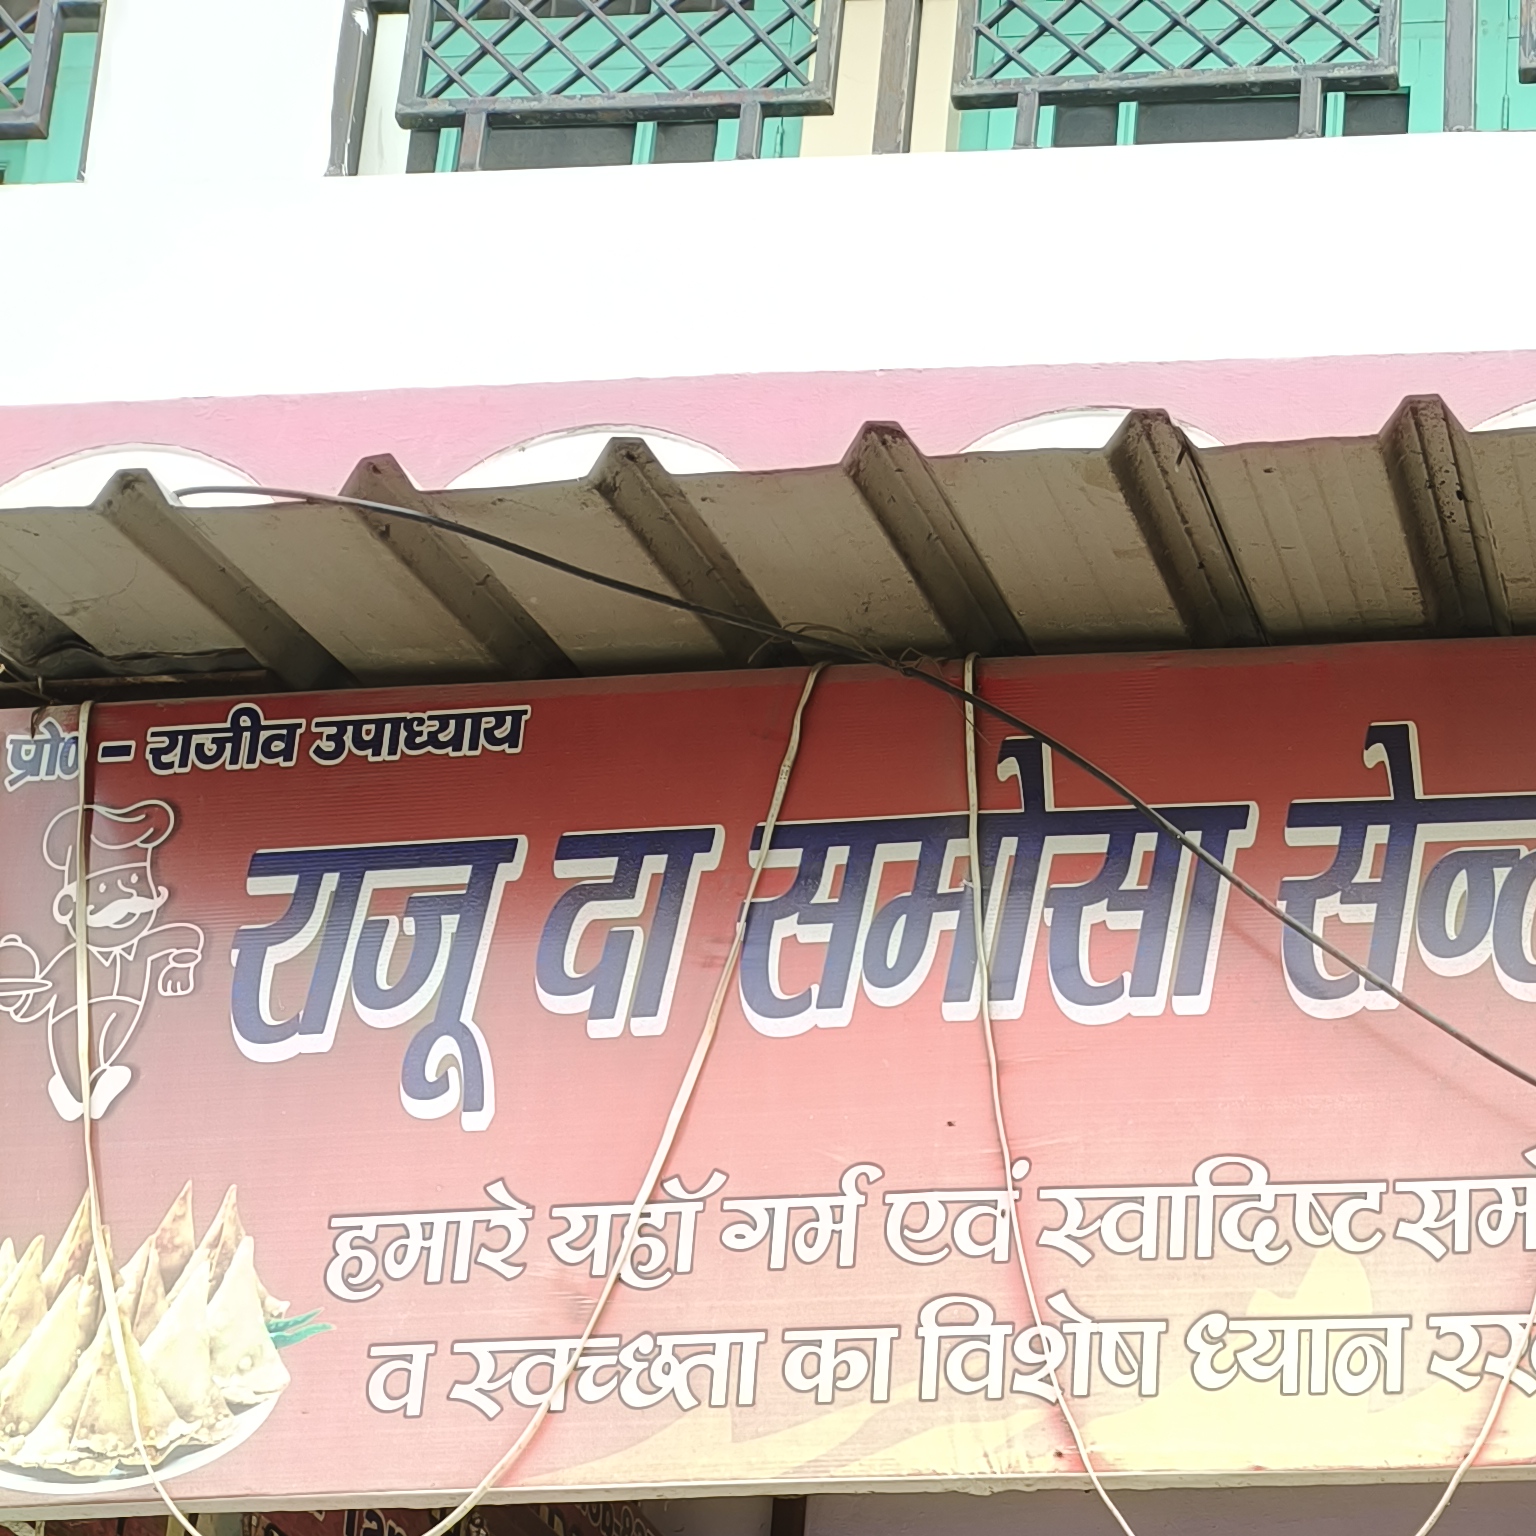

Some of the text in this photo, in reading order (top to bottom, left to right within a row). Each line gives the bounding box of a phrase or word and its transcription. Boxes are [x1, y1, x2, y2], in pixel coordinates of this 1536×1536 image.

[146, 703, 306, 774] राजीव
[310, 704, 532, 764] उपाध्याय
[231, 828, 525, 1130] राजू
[536, 825, 722, 1039] दा
[739, 733, 1259, 1040] समोसा
[325, 1177, 533, 1300] हमारे
[721, 1161, 884, 1271] गर्म
[885, 1157, 1032, 1265] एवं
[1037, 1153, 1388, 1266] स्वादिष्ट
[366, 1340, 436, 1420] व
[447, 1328, 768, 1420] स्वच्छता
[782, 1323, 901, 1405] का
[916, 1293, 1169, 1404] विशेष
[1185, 1311, 1412, 1397] ध्यान
